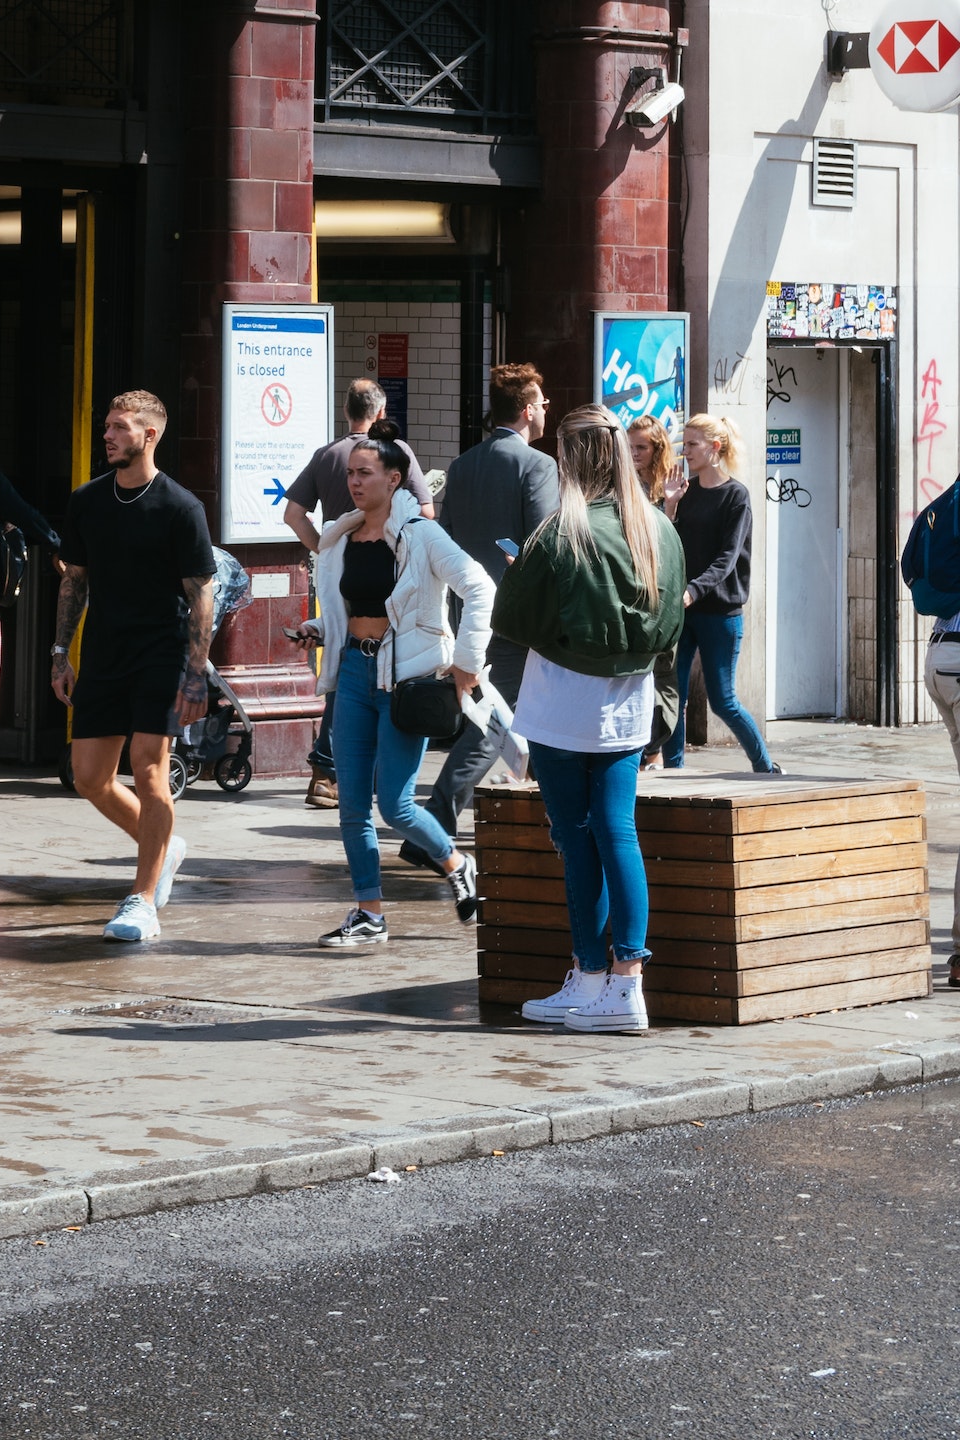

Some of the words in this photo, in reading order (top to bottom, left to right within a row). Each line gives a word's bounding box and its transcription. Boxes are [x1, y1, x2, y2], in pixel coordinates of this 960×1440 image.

[237, 342, 261, 356] This
[263, 344, 313, 357] entrance
[237, 362, 246, 376] is
[249, 363, 285, 377] closed
[766, 430, 780, 444] ire
[781, 430, 798, 444] exit
[766, 452, 780, 463] eep
[781, 450, 800, 461] clear
